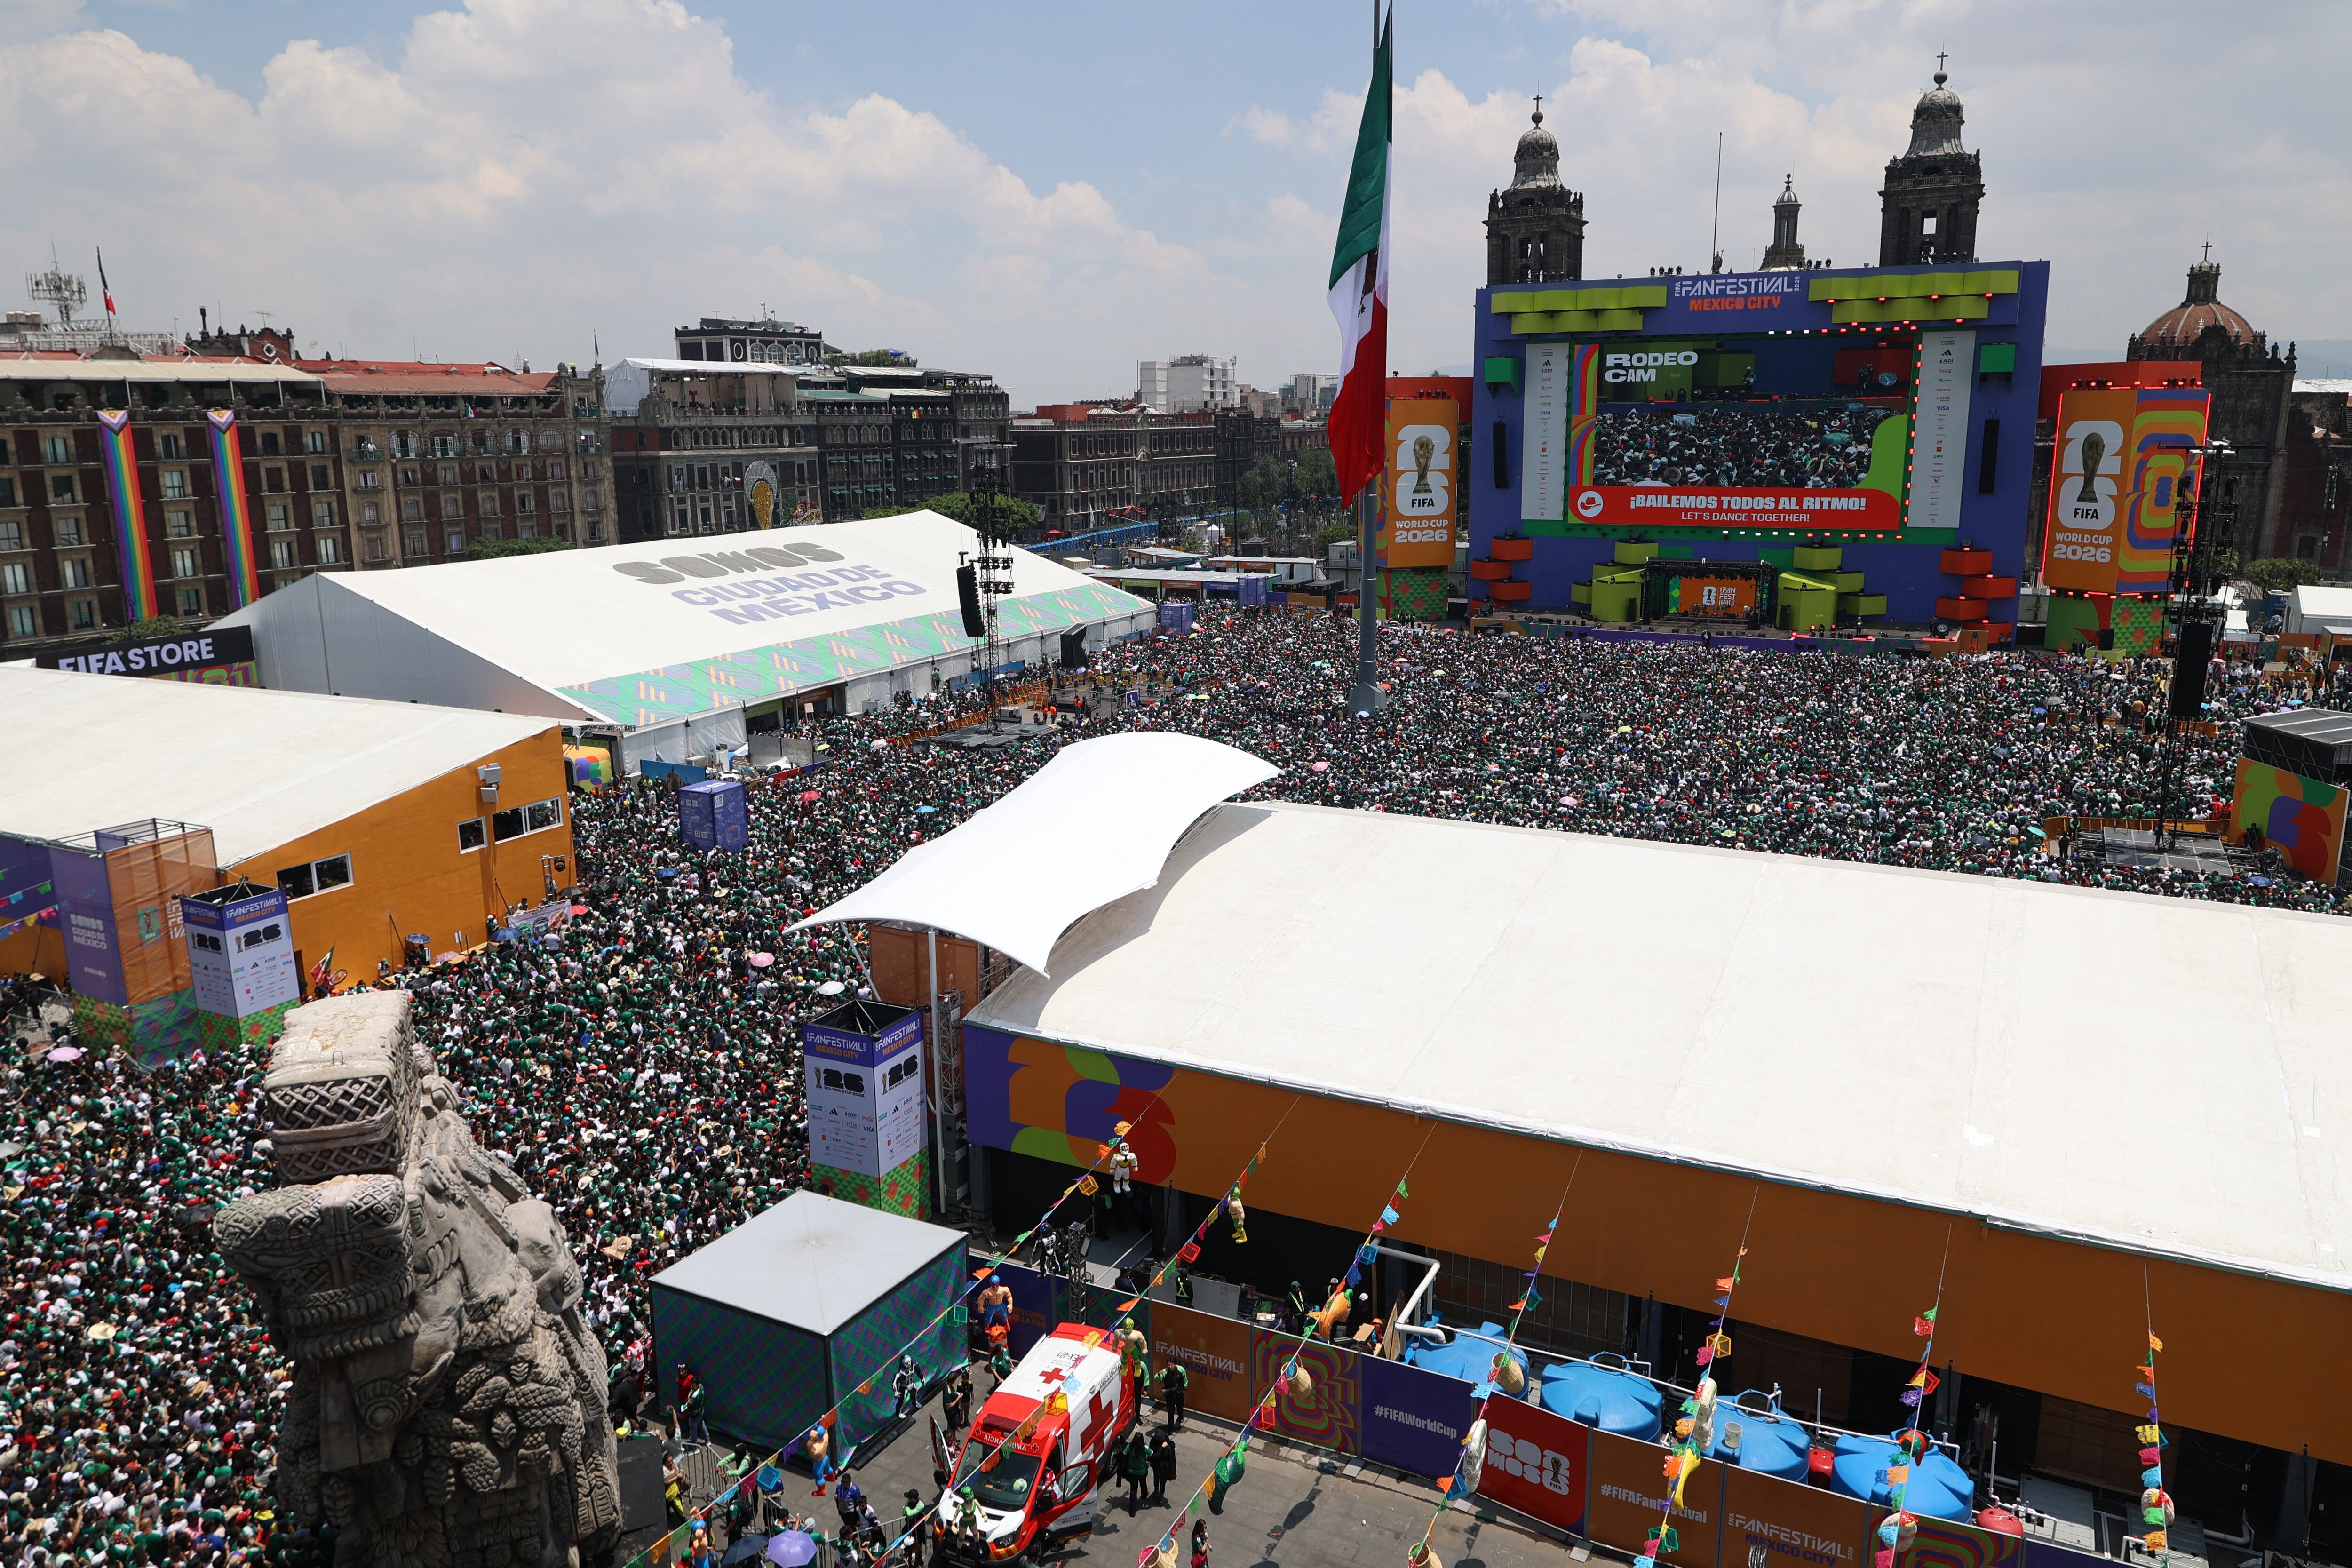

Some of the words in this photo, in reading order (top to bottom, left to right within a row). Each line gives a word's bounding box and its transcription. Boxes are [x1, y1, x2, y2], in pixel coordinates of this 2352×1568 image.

[1690, 297, 1744, 311] MEXICO
[1747, 296, 1781, 309] CITY
[1606, 351, 1698, 366] RODEO
[1605, 369, 1656, 382] CAM
[1411, 498, 1435, 508] FIFA
[1630, 495, 1717, 509] ¡BAILEMOS
[1721, 496, 1775, 509] TODOS
[1778, 497, 1799, 510] AL
[1803, 497, 1866, 510] RITMO!
[1712, 512, 1748, 521] DANCE
[1751, 513, 1810, 522] TOGETHER!
[2074, 508, 2099, 520] FIFA
[1396, 520, 1429, 528] WORLD
[1395, 529, 1448, 543] 2026
[2056, 532, 2091, 543] WORLD
[2092, 534, 2113, 545] CUP
[2053, 544, 2111, 563] 2026
[612, 542, 845, 585] SOMOS
[671, 573, 840, 605] CIUDAD
[826, 565, 895, 582] DE
[709, 581, 927, 625] MÉXICO
[127, 638, 215, 669] STORE
[72, 927, 96, 938] CIUDAD
[816, 1044, 842, 1056] MEXICO
[843, 1050, 858, 1059] CITY
[882, 1041, 903, 1056] MEXICO
[903, 1032, 914, 1046] CITY
[909, 1071, 918, 1079] 2026
[1099, 1365, 1118, 1388] AMBULANCIA
[1209, 1369, 1232, 1382] CITY
[1375, 1405, 1457, 1440] #FIFAWorldCup
[1549, 1482, 1562, 1491] FIFA
[1803, 1550, 1836, 1568] CITY
